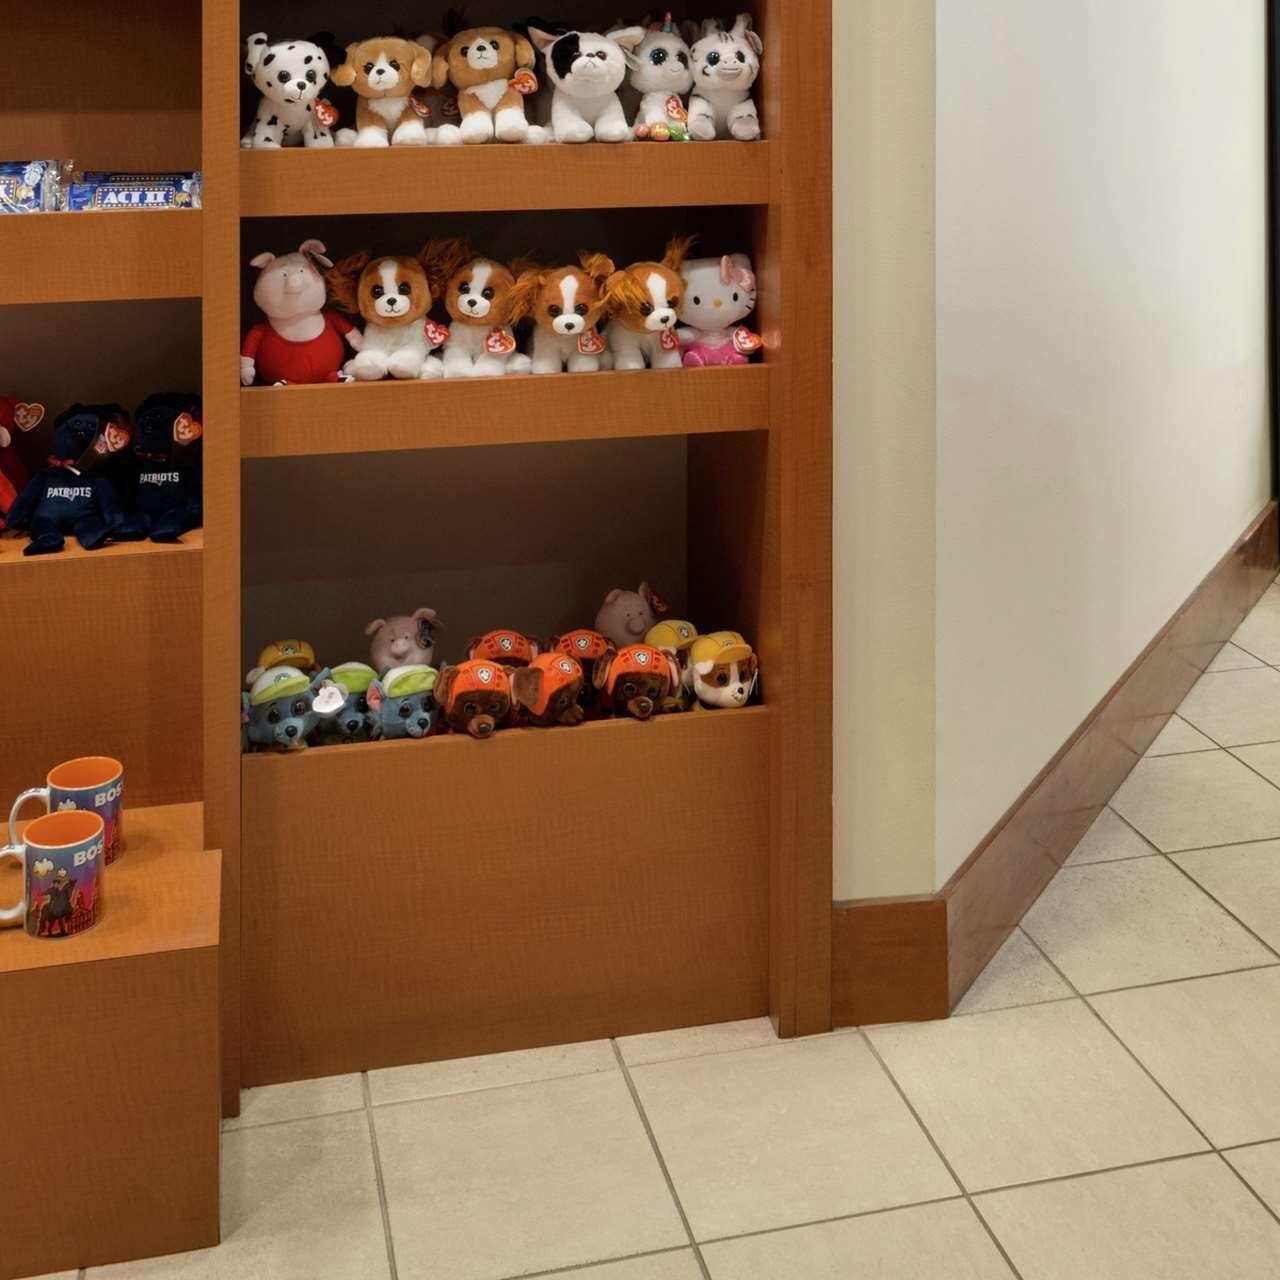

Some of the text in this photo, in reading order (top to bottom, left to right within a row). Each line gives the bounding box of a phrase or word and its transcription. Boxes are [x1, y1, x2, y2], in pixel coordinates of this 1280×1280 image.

[103, 191, 167, 204] ACT II
[140, 471, 180, 485] PATRIOTS
[46, 486, 92, 501] PATRIOTS
